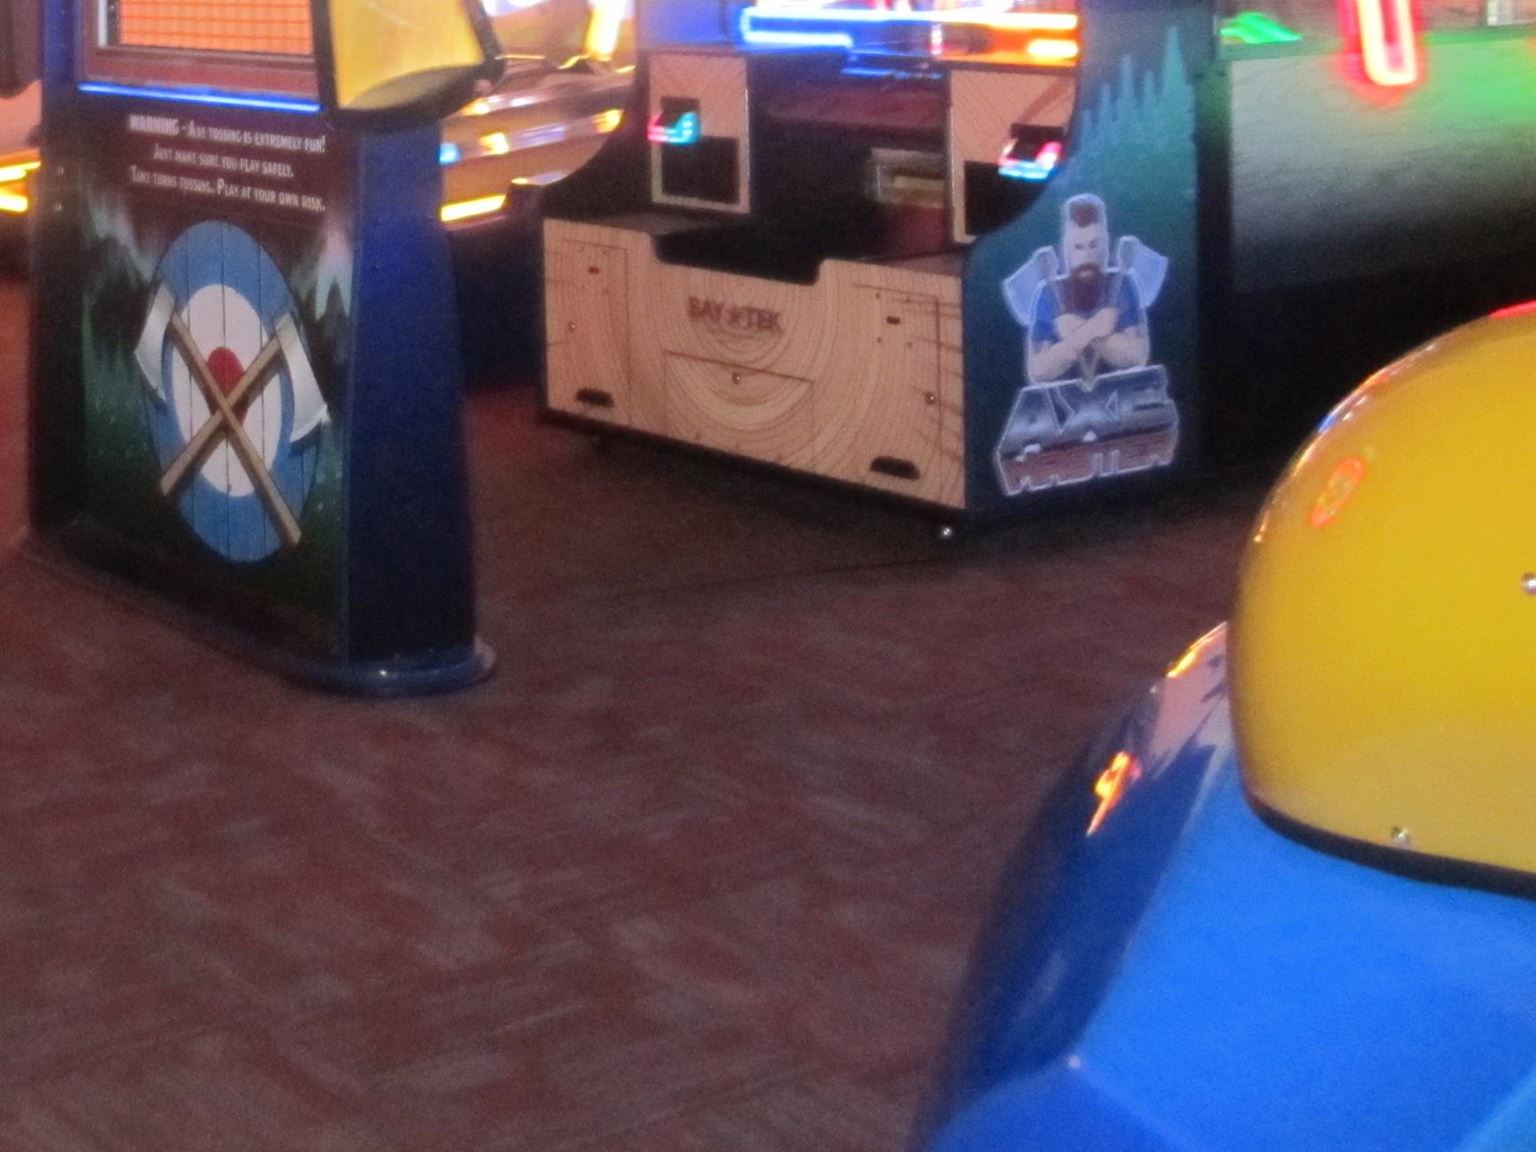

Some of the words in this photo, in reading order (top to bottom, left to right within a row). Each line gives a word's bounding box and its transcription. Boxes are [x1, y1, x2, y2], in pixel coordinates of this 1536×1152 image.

[129, 114, 179, 137] WARNING
[243, 131, 253, 145] IS
[254, 132, 302, 151] EXTREMELY
[304, 135, 326, 153] FUN!
[199, 152, 221, 168] SURE
[222, 155, 237, 171] YOU
[240, 158, 261, 173] PLAY
[262, 161, 295, 178] SAFELY.
[217, 178, 240, 197] PLAY
[241, 186, 251, 200] AT
[254, 188, 276, 204] YOUR
[278, 191, 299, 207] OWN
[301, 194, 326, 212] RISK.
[688, 296, 723, 323] BAY
[743, 305, 784, 334] TEK
[1000, 366, 1178, 459] AXE
[1000, 429, 1177, 495] MASTER
